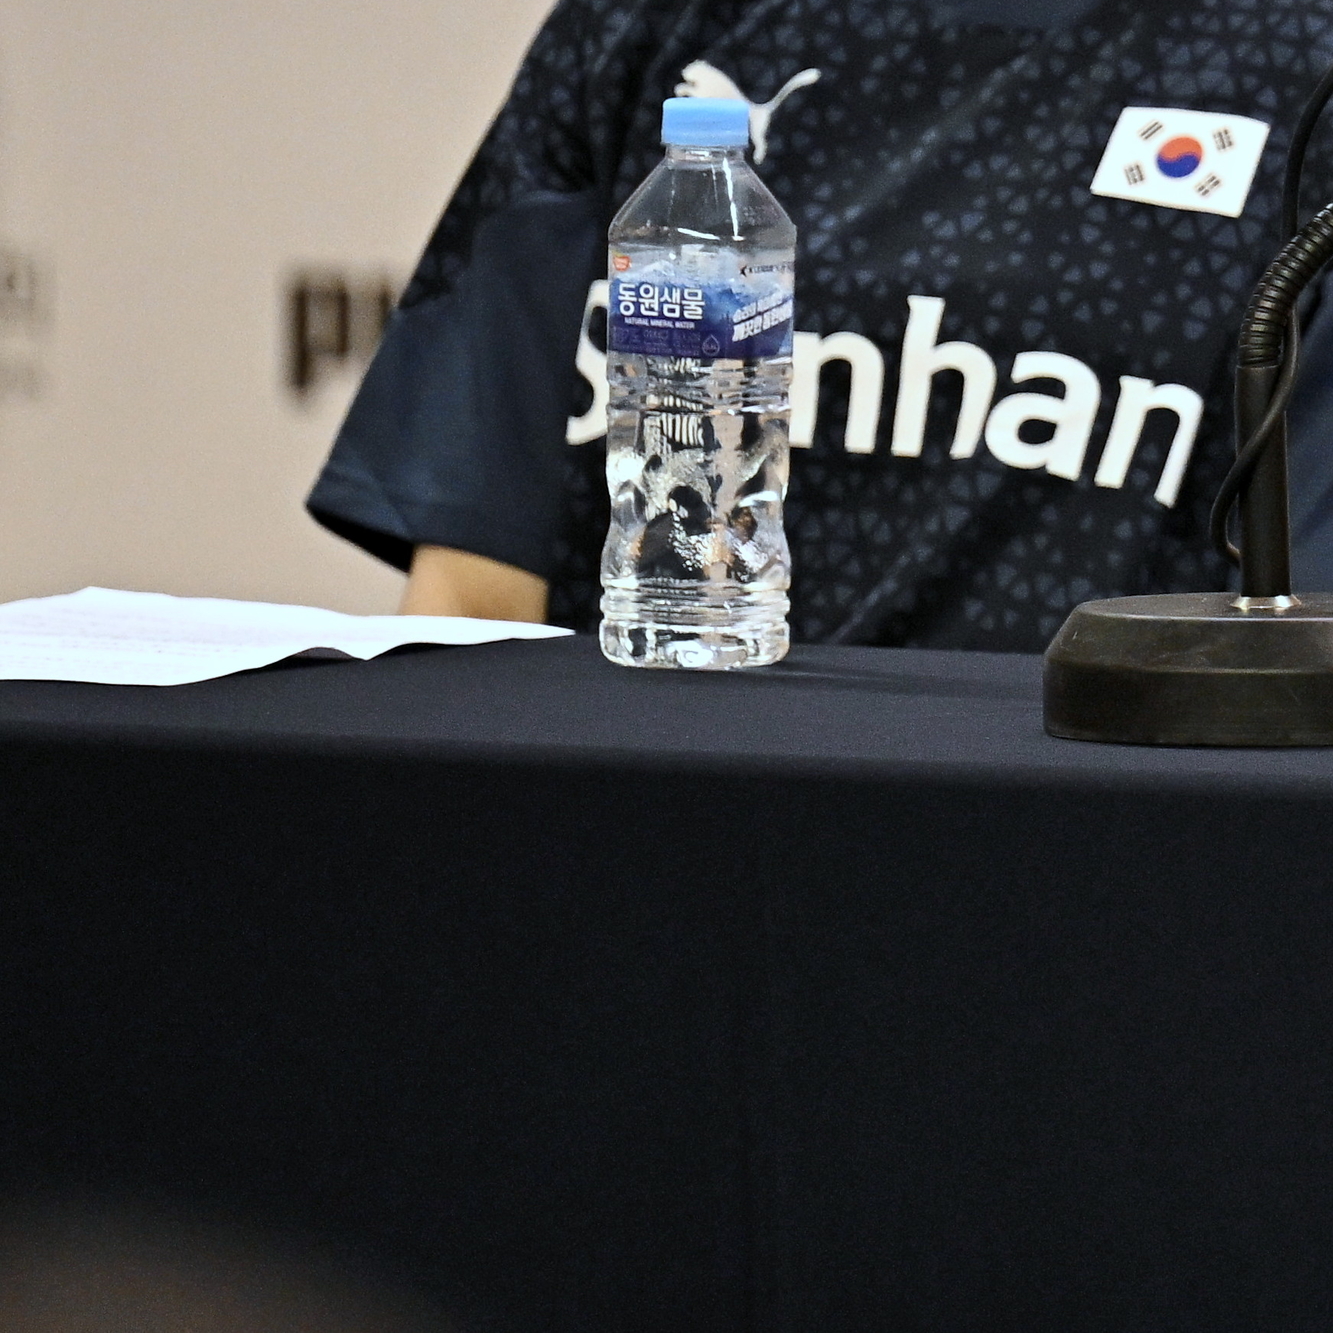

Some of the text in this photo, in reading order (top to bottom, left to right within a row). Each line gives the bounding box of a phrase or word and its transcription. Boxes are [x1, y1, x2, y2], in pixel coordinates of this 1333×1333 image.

[617, 282, 706, 320] 동원샘물
[624, 316, 696, 330] NATURAL MINERAL WATER
[566, 279, 1204, 508] nhan
